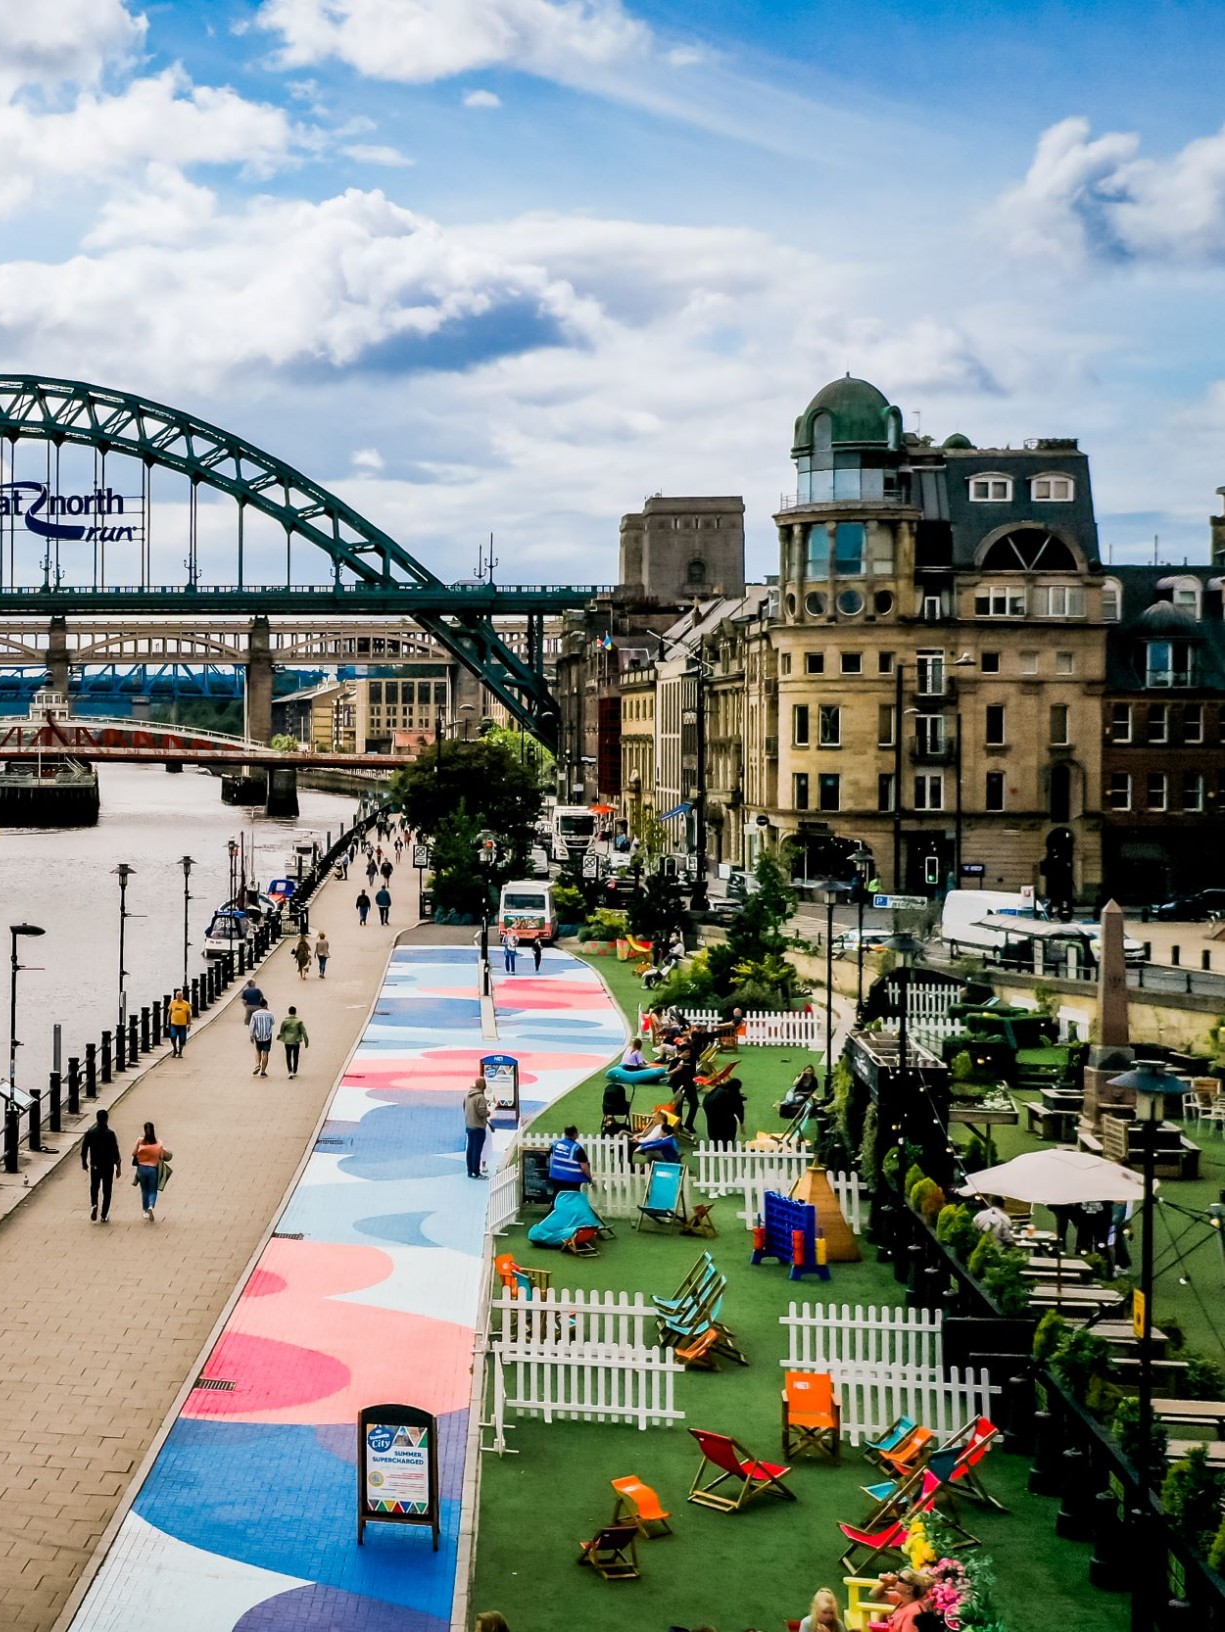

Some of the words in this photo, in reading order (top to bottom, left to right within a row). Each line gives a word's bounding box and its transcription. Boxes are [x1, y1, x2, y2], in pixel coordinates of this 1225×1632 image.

[50, 488, 123, 515] north
[85, 526, 133, 542] run
[372, 1440, 390, 1449] City
[372, 1457, 424, 1465] SUPERCHARGED
